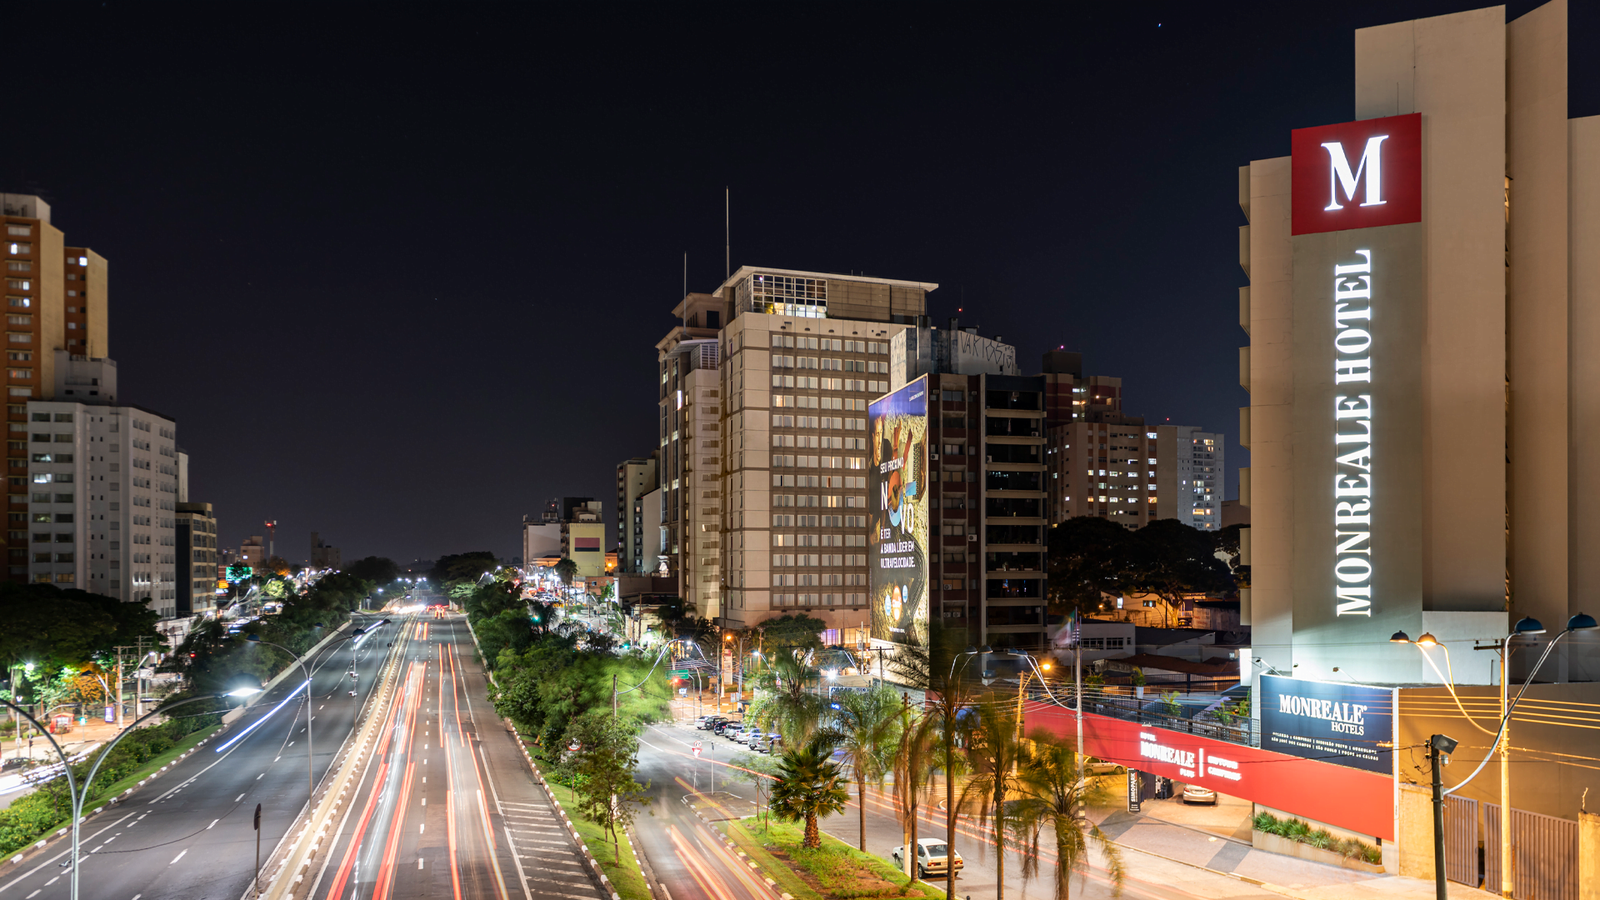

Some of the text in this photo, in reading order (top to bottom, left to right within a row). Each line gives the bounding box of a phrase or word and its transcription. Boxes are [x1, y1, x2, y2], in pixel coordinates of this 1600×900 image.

[1320, 134, 1390, 212] M
[1335, 249, 1372, 617] MONREALE HOTEL
[884, 542, 896, 554] BANDA
[1279, 694, 1364, 725] MONREALE
[1331, 721, 1364, 736] HOTELS
